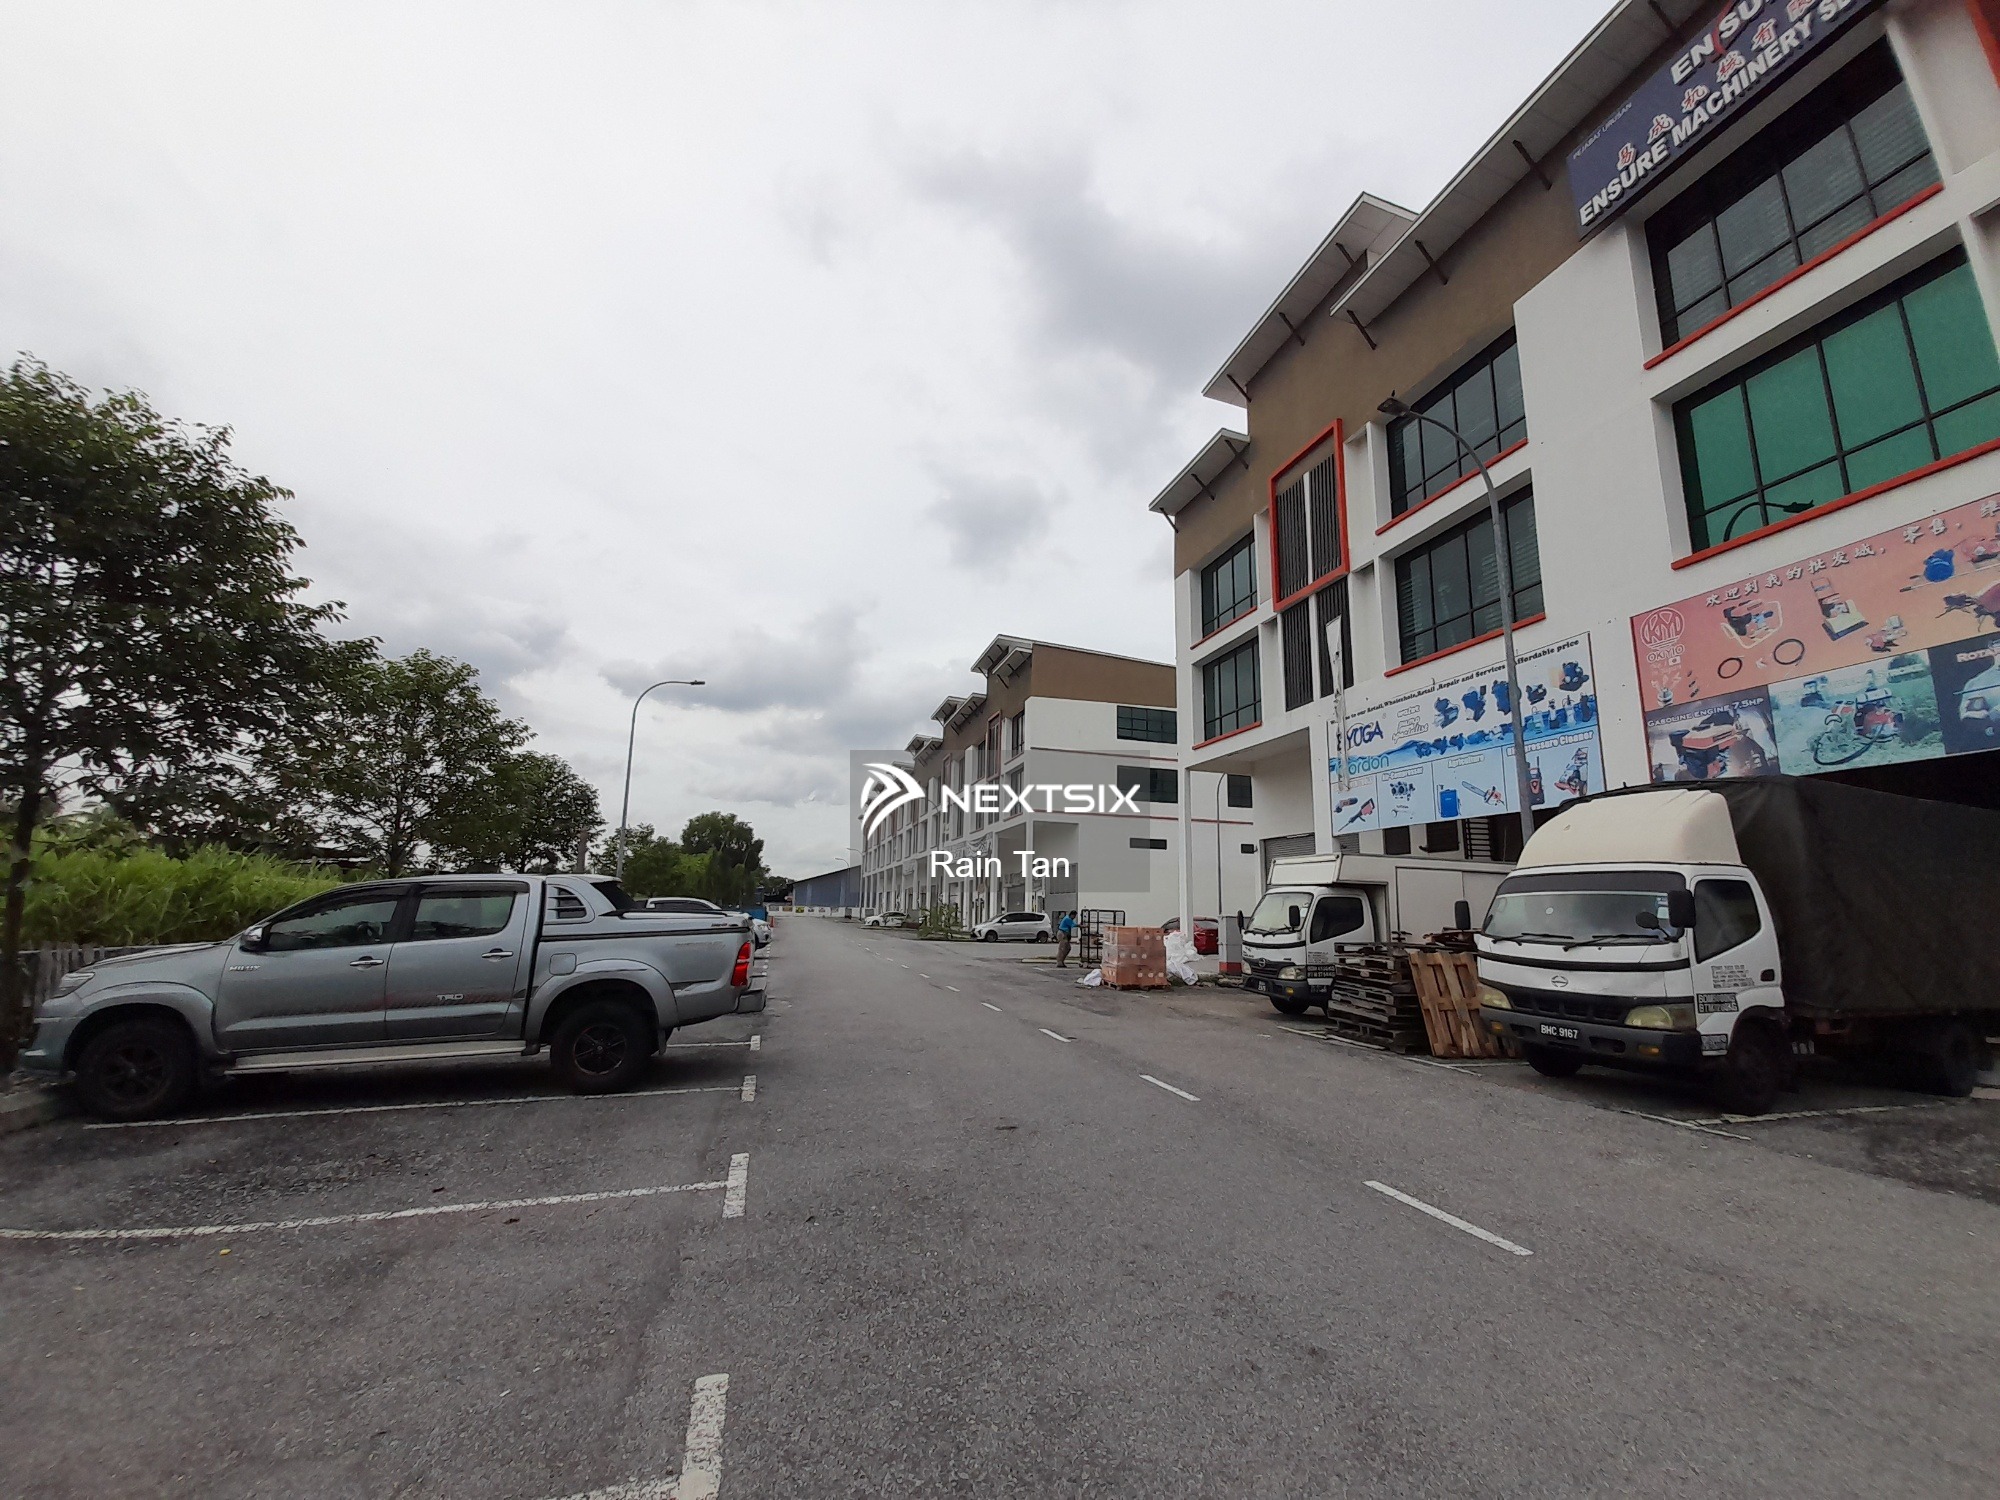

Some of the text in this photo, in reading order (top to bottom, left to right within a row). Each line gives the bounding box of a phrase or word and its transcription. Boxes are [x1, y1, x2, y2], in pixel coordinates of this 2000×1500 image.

[1579, 136, 1669, 226] ENSURE
[1671, 12, 1813, 147] MACHINERY
[1461, 673, 1474, 682] and
[1475, 663, 1506, 678] Services
[1515, 648, 1555, 665] ffordable
[1556, 639, 1579, 653] price
[1647, 698, 1764, 727] GASOLINE ENGINE 7.5HP
[1346, 721, 1383, 751] YOGA
[1337, 755, 1390, 777] ordon
[1540, 1024, 1578, 1039] BHC 9167
